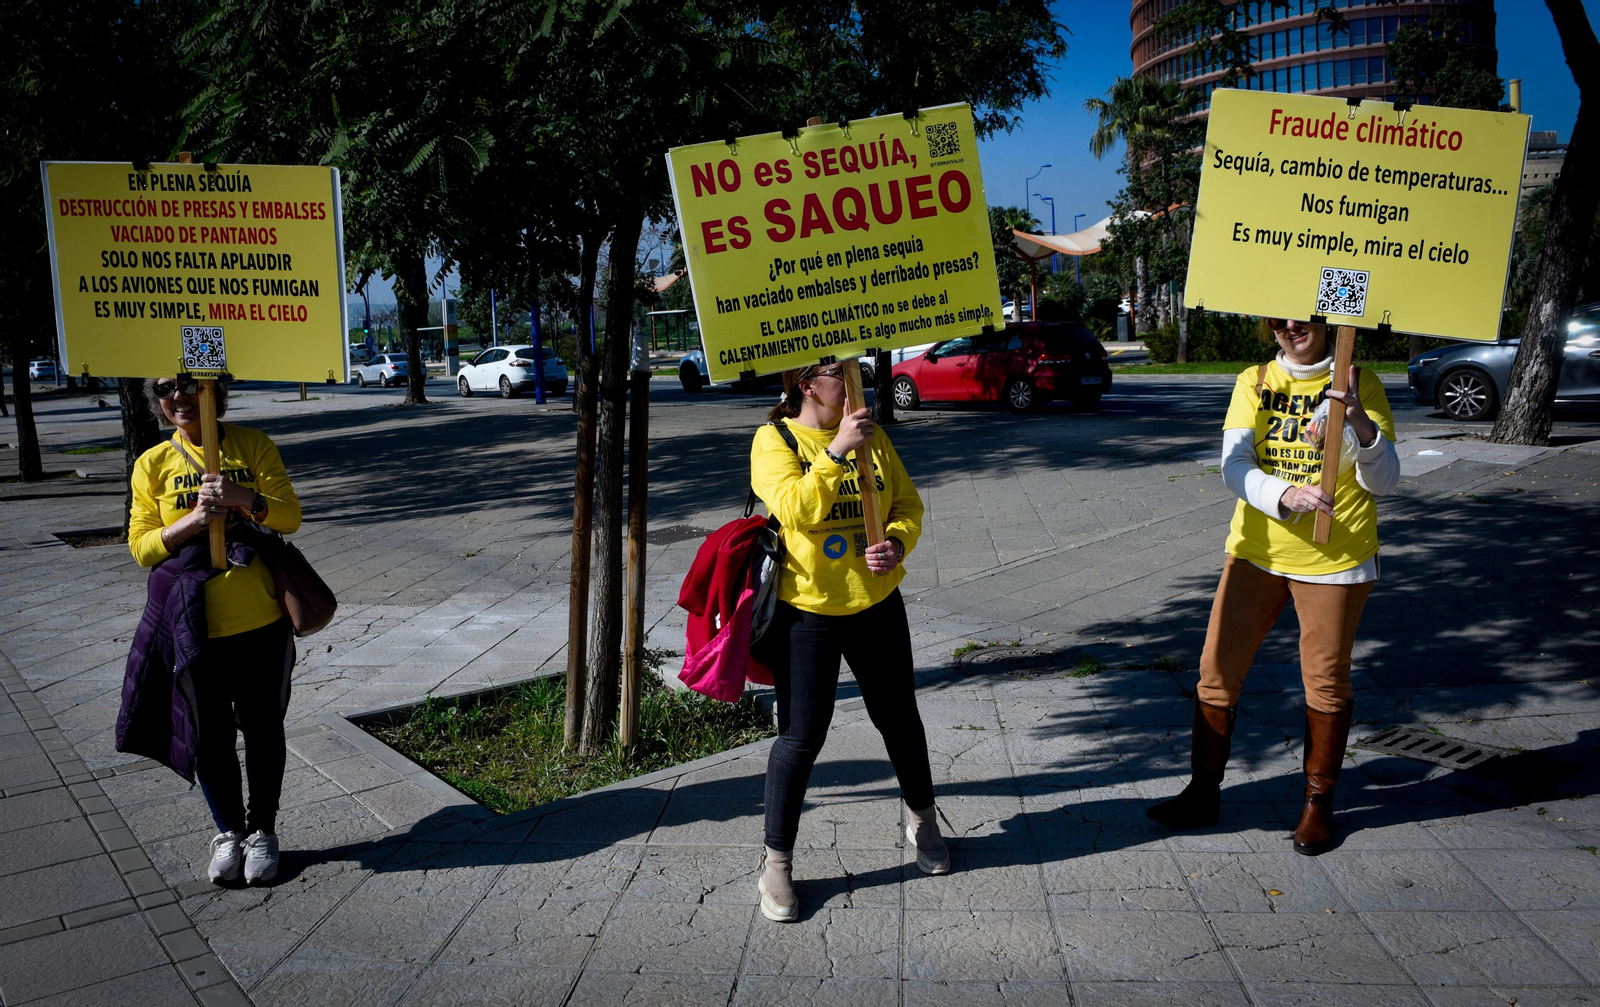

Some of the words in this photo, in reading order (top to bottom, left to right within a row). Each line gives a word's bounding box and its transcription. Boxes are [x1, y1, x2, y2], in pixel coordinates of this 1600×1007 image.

[1269, 108, 1349, 141] Fraude
[1356, 115, 1463, 151] climático
[690, 158, 741, 198] NO
[754, 159, 793, 187] es
[803, 133, 918, 179] SEQUÍA,
[929, 157, 965, 168] @TIERRAYSALUD
[1213, 149, 1275, 177] Sequía,
[1280, 157, 1343, 179] cambio
[1348, 160, 1370, 182] de
[1374, 164, 1508, 196] temperaturas...
[128, 173, 147, 191] EN
[150, 174, 196, 191] PLENA
[199, 170, 252, 192] SEQUÍA
[59, 195, 158, 217] DESTRUCCIÓN
[162, 200, 180, 217] DE
[183, 200, 236, 218] PRESAS
[239, 201, 248, 218] Y
[252, 201, 326, 220] EMBALSES
[701, 215, 752, 255] ES
[764, 169, 972, 243] SAQUEO
[1301, 192, 1334, 215] Nos
[1338, 195, 1409, 225] fumigan
[110, 225, 175, 243] VACIADO
[179, 226, 197, 243] DE
[201, 226, 277, 245] PANTANOS
[1232, 222, 1250, 243] Es
[1255, 228, 1293, 251] muy
[1296, 228, 1358, 257] simple,
[1364, 236, 1403, 258] mira
[1408, 239, 1425, 260] el
[1428, 243, 1469, 265] cielo
[101, 250, 138, 268] SOLO
[142, 251, 172, 269] NOS
[175, 252, 217, 269] FALTA
[221, 252, 292, 271] APLAUDIR
[769, 258, 796, 282] ¿Por
[800, 251, 823, 276] qué
[826, 252, 842, 267] en
[845, 245, 880, 268] plena
[883, 235, 924, 259] sequía
[79, 276, 89, 292] A
[92, 276, 118, 293] LOS
[122, 276, 183, 294] AVIONES
[187, 277, 216, 295] QUE
[219, 278, 249, 295] NOS
[252, 279, 319, 297] FUMIGAN
[716, 296, 741, 314] han
[743, 285, 794, 309] vaciado
[797, 276, 857, 300] embalses
[859, 275, 867, 294] y
[870, 261, 930, 287] derribado
[933, 251, 979, 281] presas?
[94, 301, 110, 318] ES
[114, 301, 146, 318] MUY
[150, 302, 206, 322] SIMPLE,
[208, 303, 247, 320] MIRA
[250, 304, 266, 321] EL
[268, 304, 308, 322] CIELO
[760, 321, 775, 337] EL
[776, 312, 819, 334] CAMBIO
[821, 302, 879, 326] CLIMÁTICO
[881, 303, 895, 315] no
[897, 300, 909, 313] se
[911, 293, 936, 310] debe
[938, 289, 949, 305] al
[719, 335, 809, 365] CALENTAMIENTO
[811, 328, 857, 349] GLOBAL.
[859, 325, 872, 340] Es
[875, 322, 896, 339] algo
[898, 315, 933, 333] mucho
[934, 310, 956, 324] más
[958, 304, 994, 323] simple.
[1265, 447, 1277, 457] NO
[1280, 449, 1291, 458] ES
[1294, 450, 1304, 459] LO
[174, 468, 255, 490] PANTAS
[1271, 468, 1305, 483] OBJETIVO
[1282, 461, 1299, 471] HAN
[1302, 464, 1322, 473] DICH
